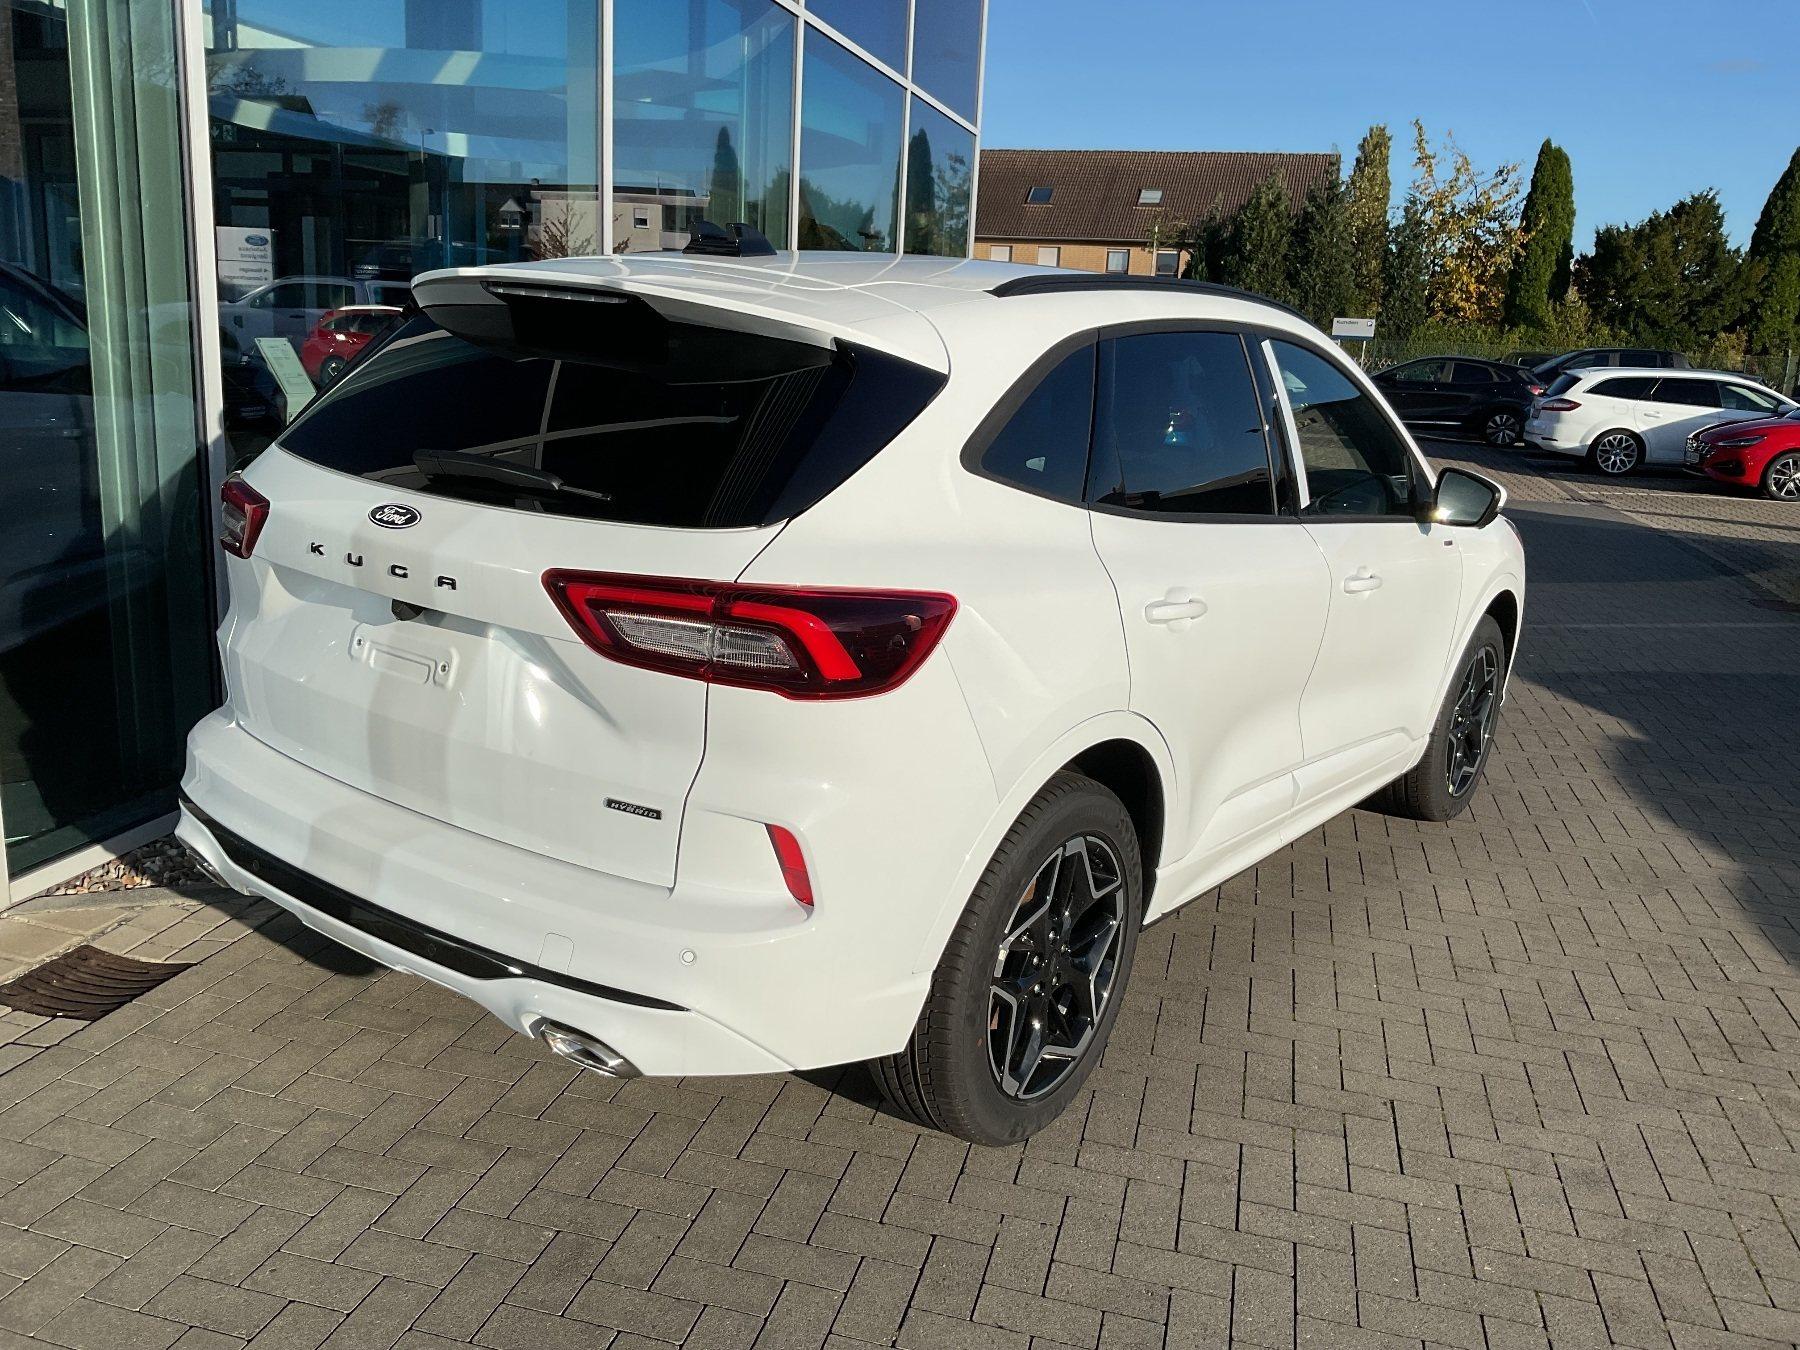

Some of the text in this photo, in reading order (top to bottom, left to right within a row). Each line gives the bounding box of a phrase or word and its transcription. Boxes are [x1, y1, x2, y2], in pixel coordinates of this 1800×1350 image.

[374, 505, 413, 525] Ford
[310, 541, 457, 590] KUGA
[610, 802, 657, 818] HYBRID
